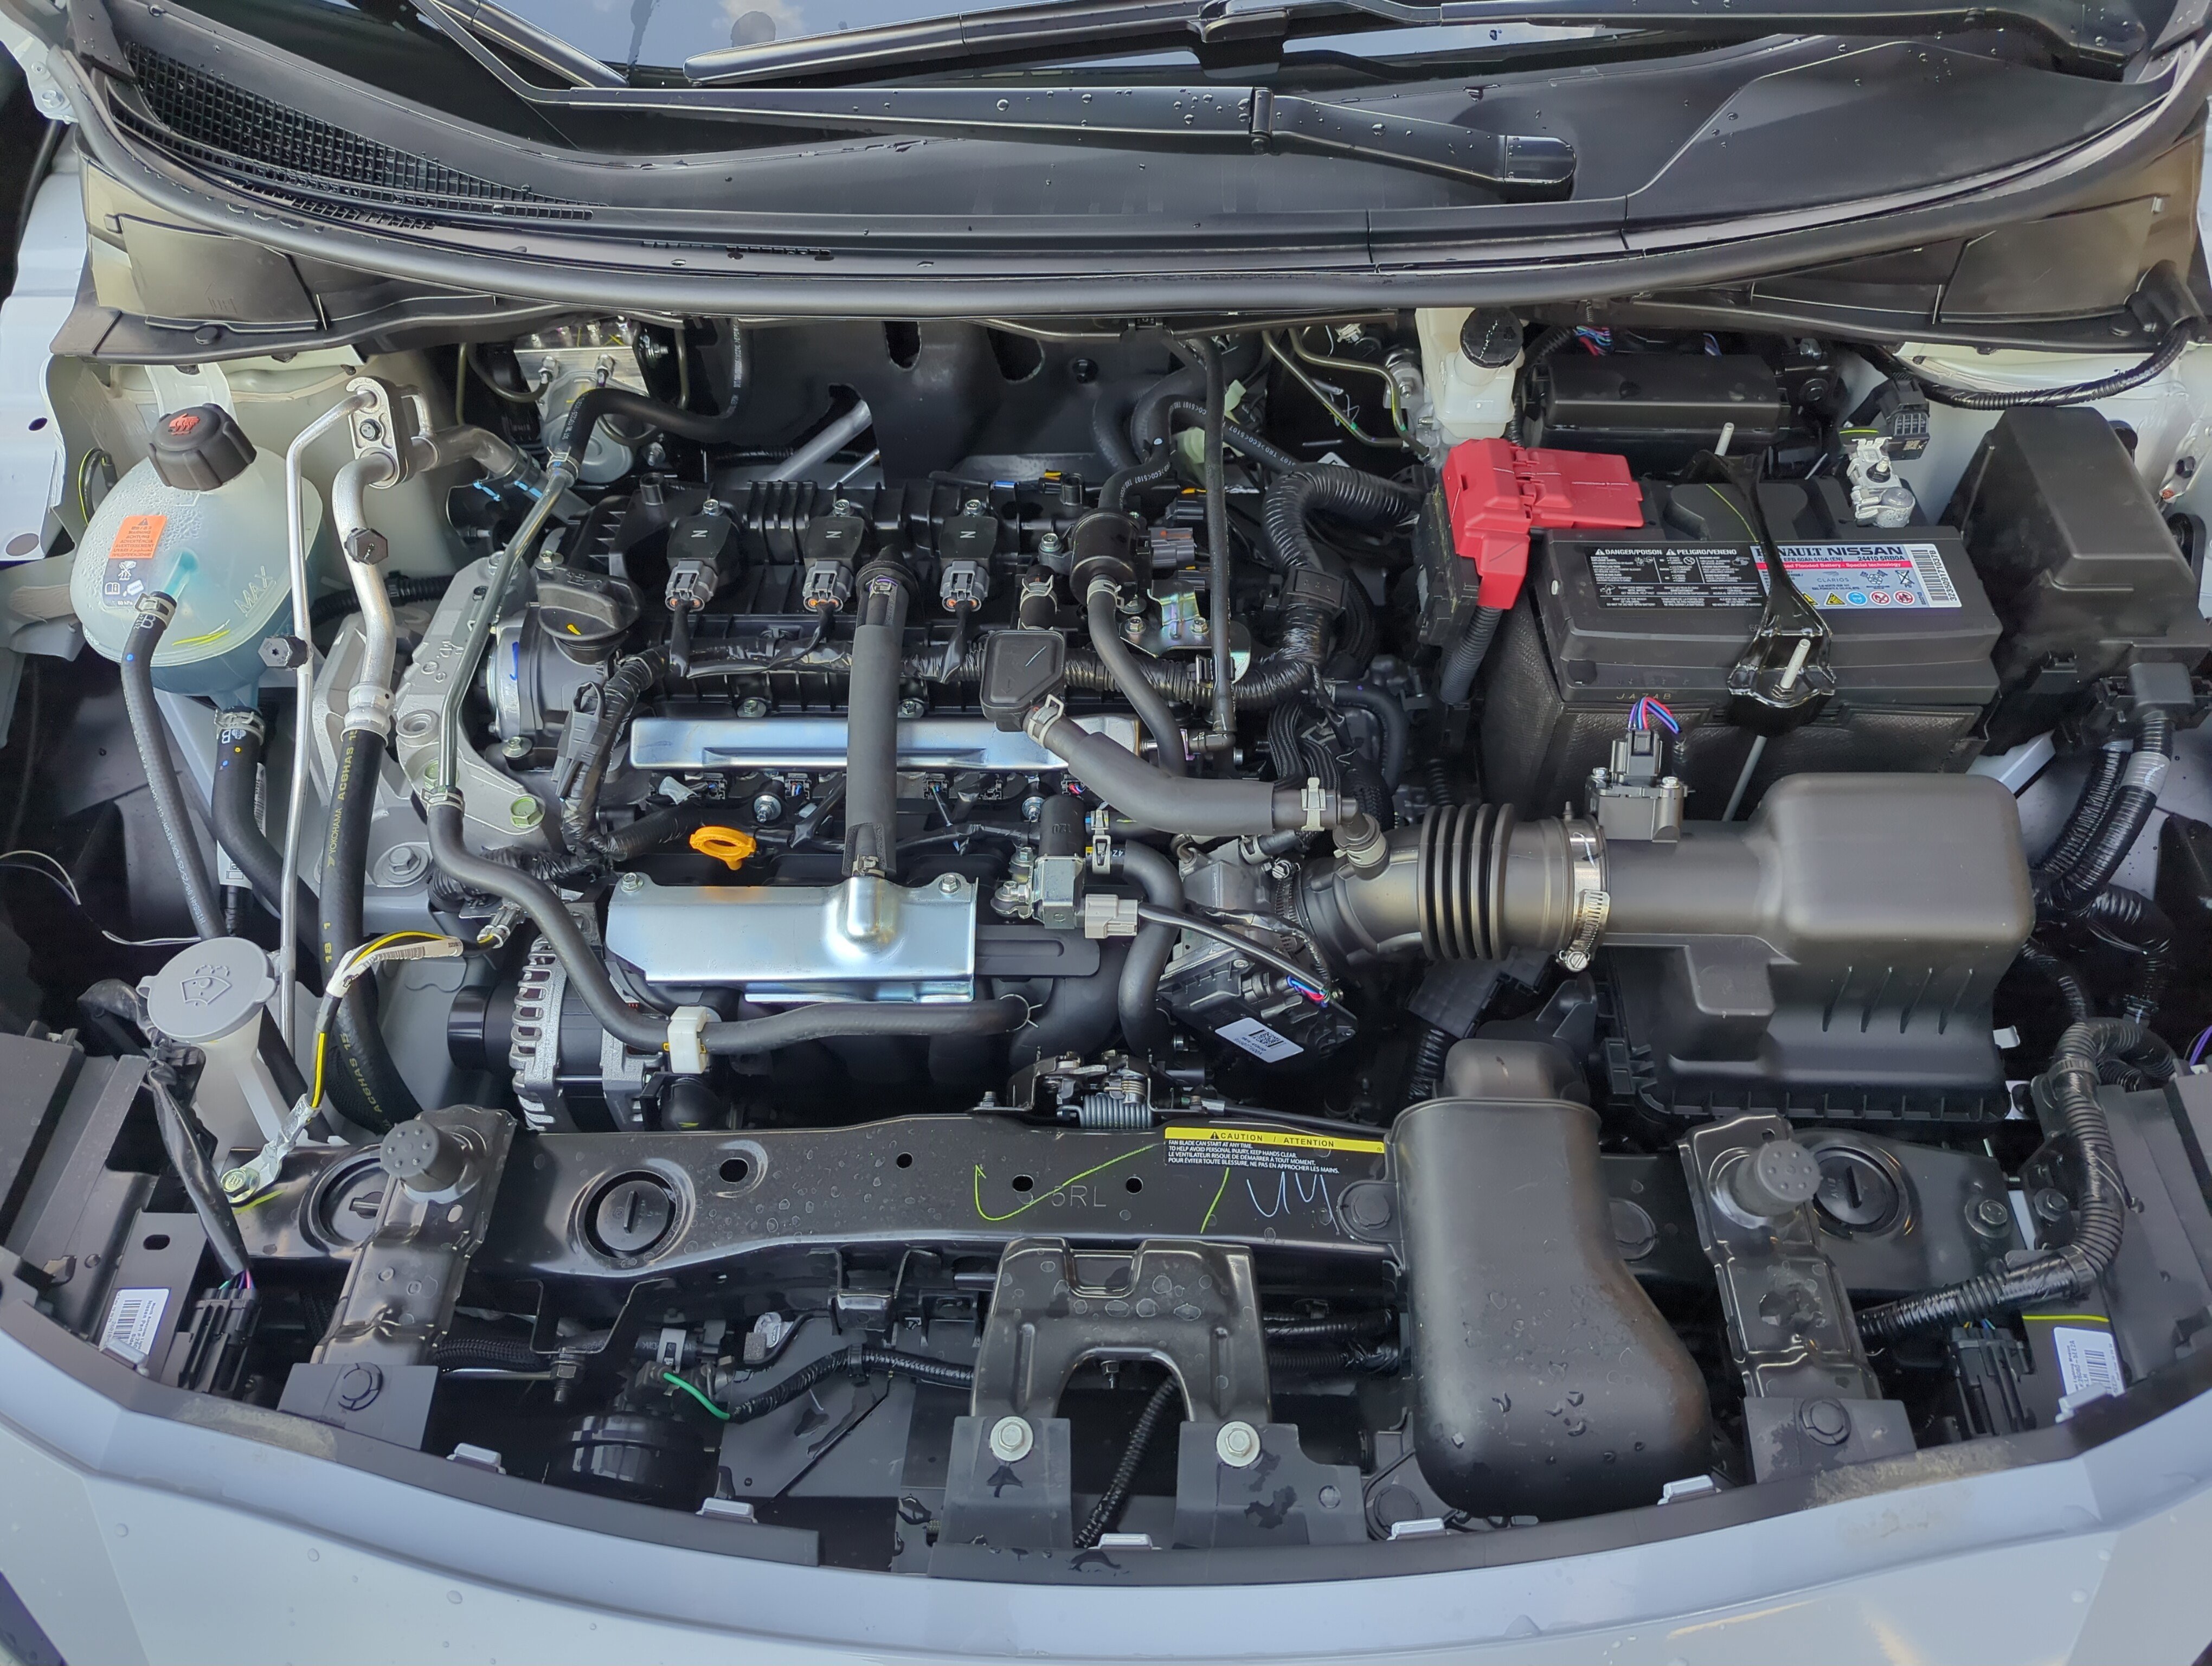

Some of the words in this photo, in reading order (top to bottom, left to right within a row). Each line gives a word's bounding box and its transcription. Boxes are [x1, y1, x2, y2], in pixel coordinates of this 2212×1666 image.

[1827, 547, 1903, 556] NISSAN
[234, 565, 274, 613] MAX
[329, 808, 343, 855] YOKOHAMA
[190, 896, 207, 925] NISSAN
[323, 942, 333, 963] 18
[340, 1032, 352, 1050] 15
[1221, 1133, 1263, 1141] CAUTION
[1283, 1137, 1334, 1147] ATTENTION
[1240, 1154, 1269, 1162] DÉMARRER
[1052, 1185, 1107, 1207] 5RL
[143, 1300, 152, 1318] Nissan
